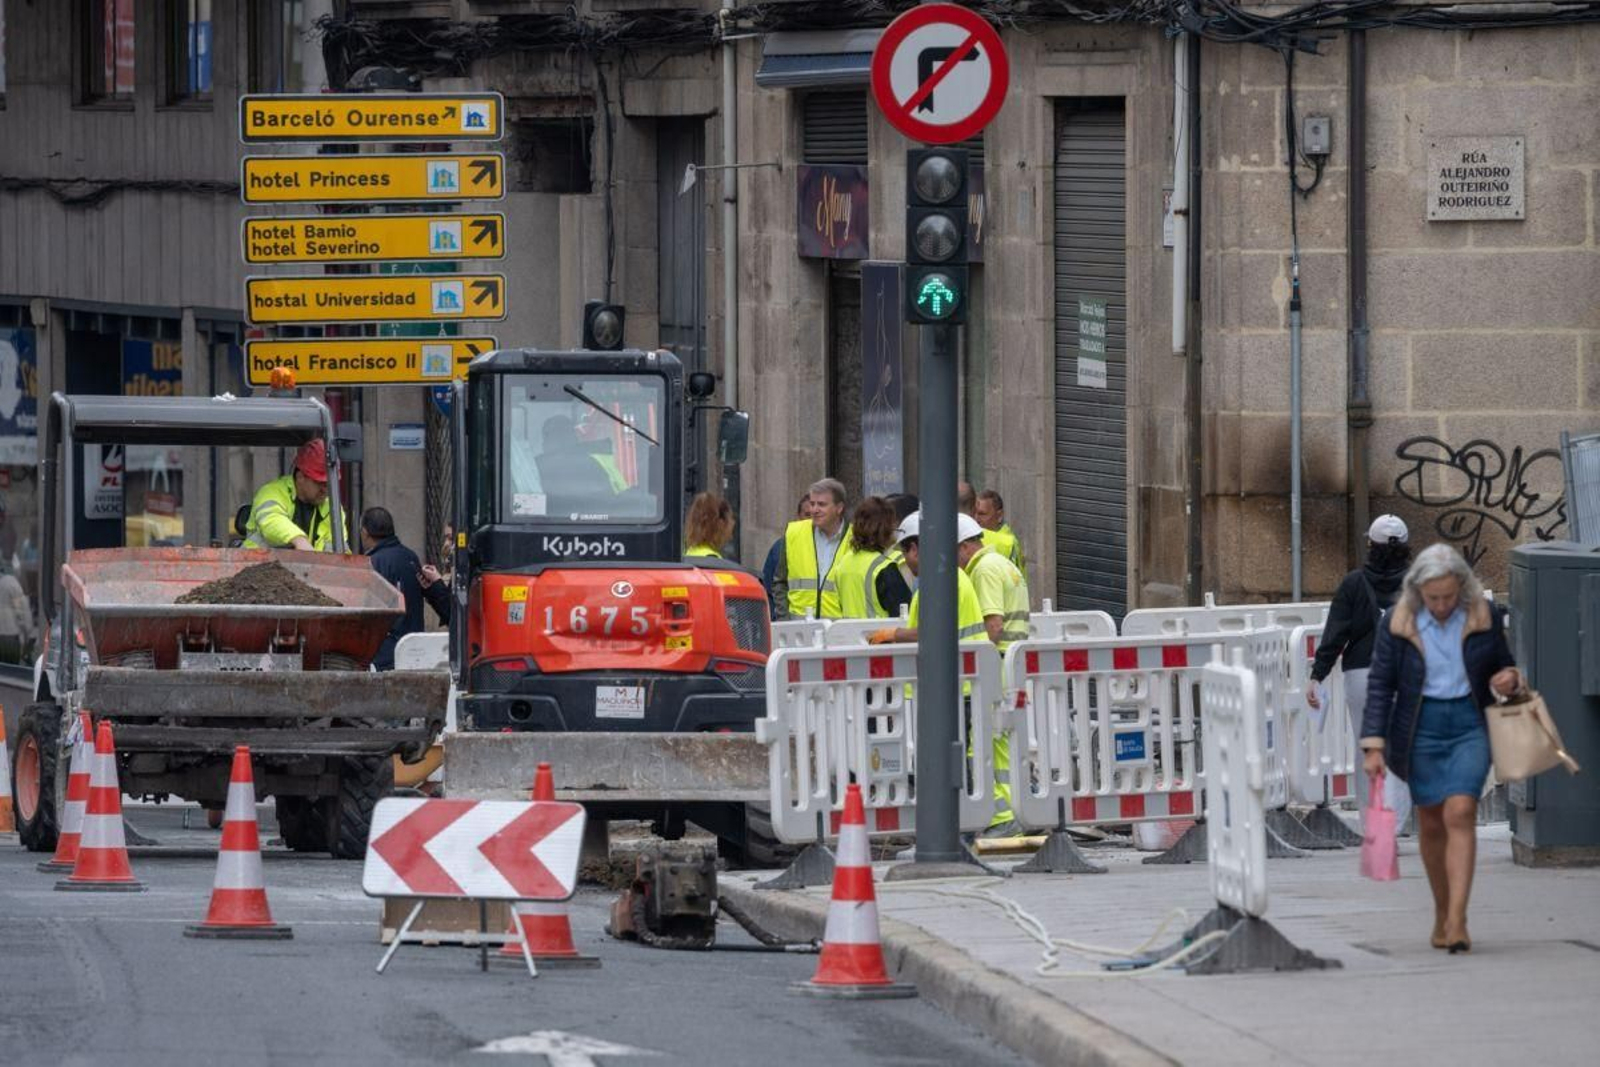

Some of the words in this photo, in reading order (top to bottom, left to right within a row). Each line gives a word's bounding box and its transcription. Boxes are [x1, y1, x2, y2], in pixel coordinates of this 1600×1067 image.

[252, 109, 335, 128] Barceló
[347, 109, 440, 127] Ourense
[1461, 150, 1487, 164] RÚA
[250, 172, 300, 188] hotel
[310, 171, 391, 187] Princess
[1439, 167, 1511, 180] ALEJANDRO
[1440, 179, 1510, 193] OUTEIRIÑO
[252, 225, 296, 240] hotel
[304, 225, 357, 239] Bamio
[252, 242, 297, 256] hotel
[306, 240, 381, 255] Severino
[254, 292, 308, 308] hostal
[315, 291, 416, 307] Universidad
[253, 355, 300, 372] hotel
[308, 353, 398, 371] Francisco
[543, 536, 626, 557] Kubota
